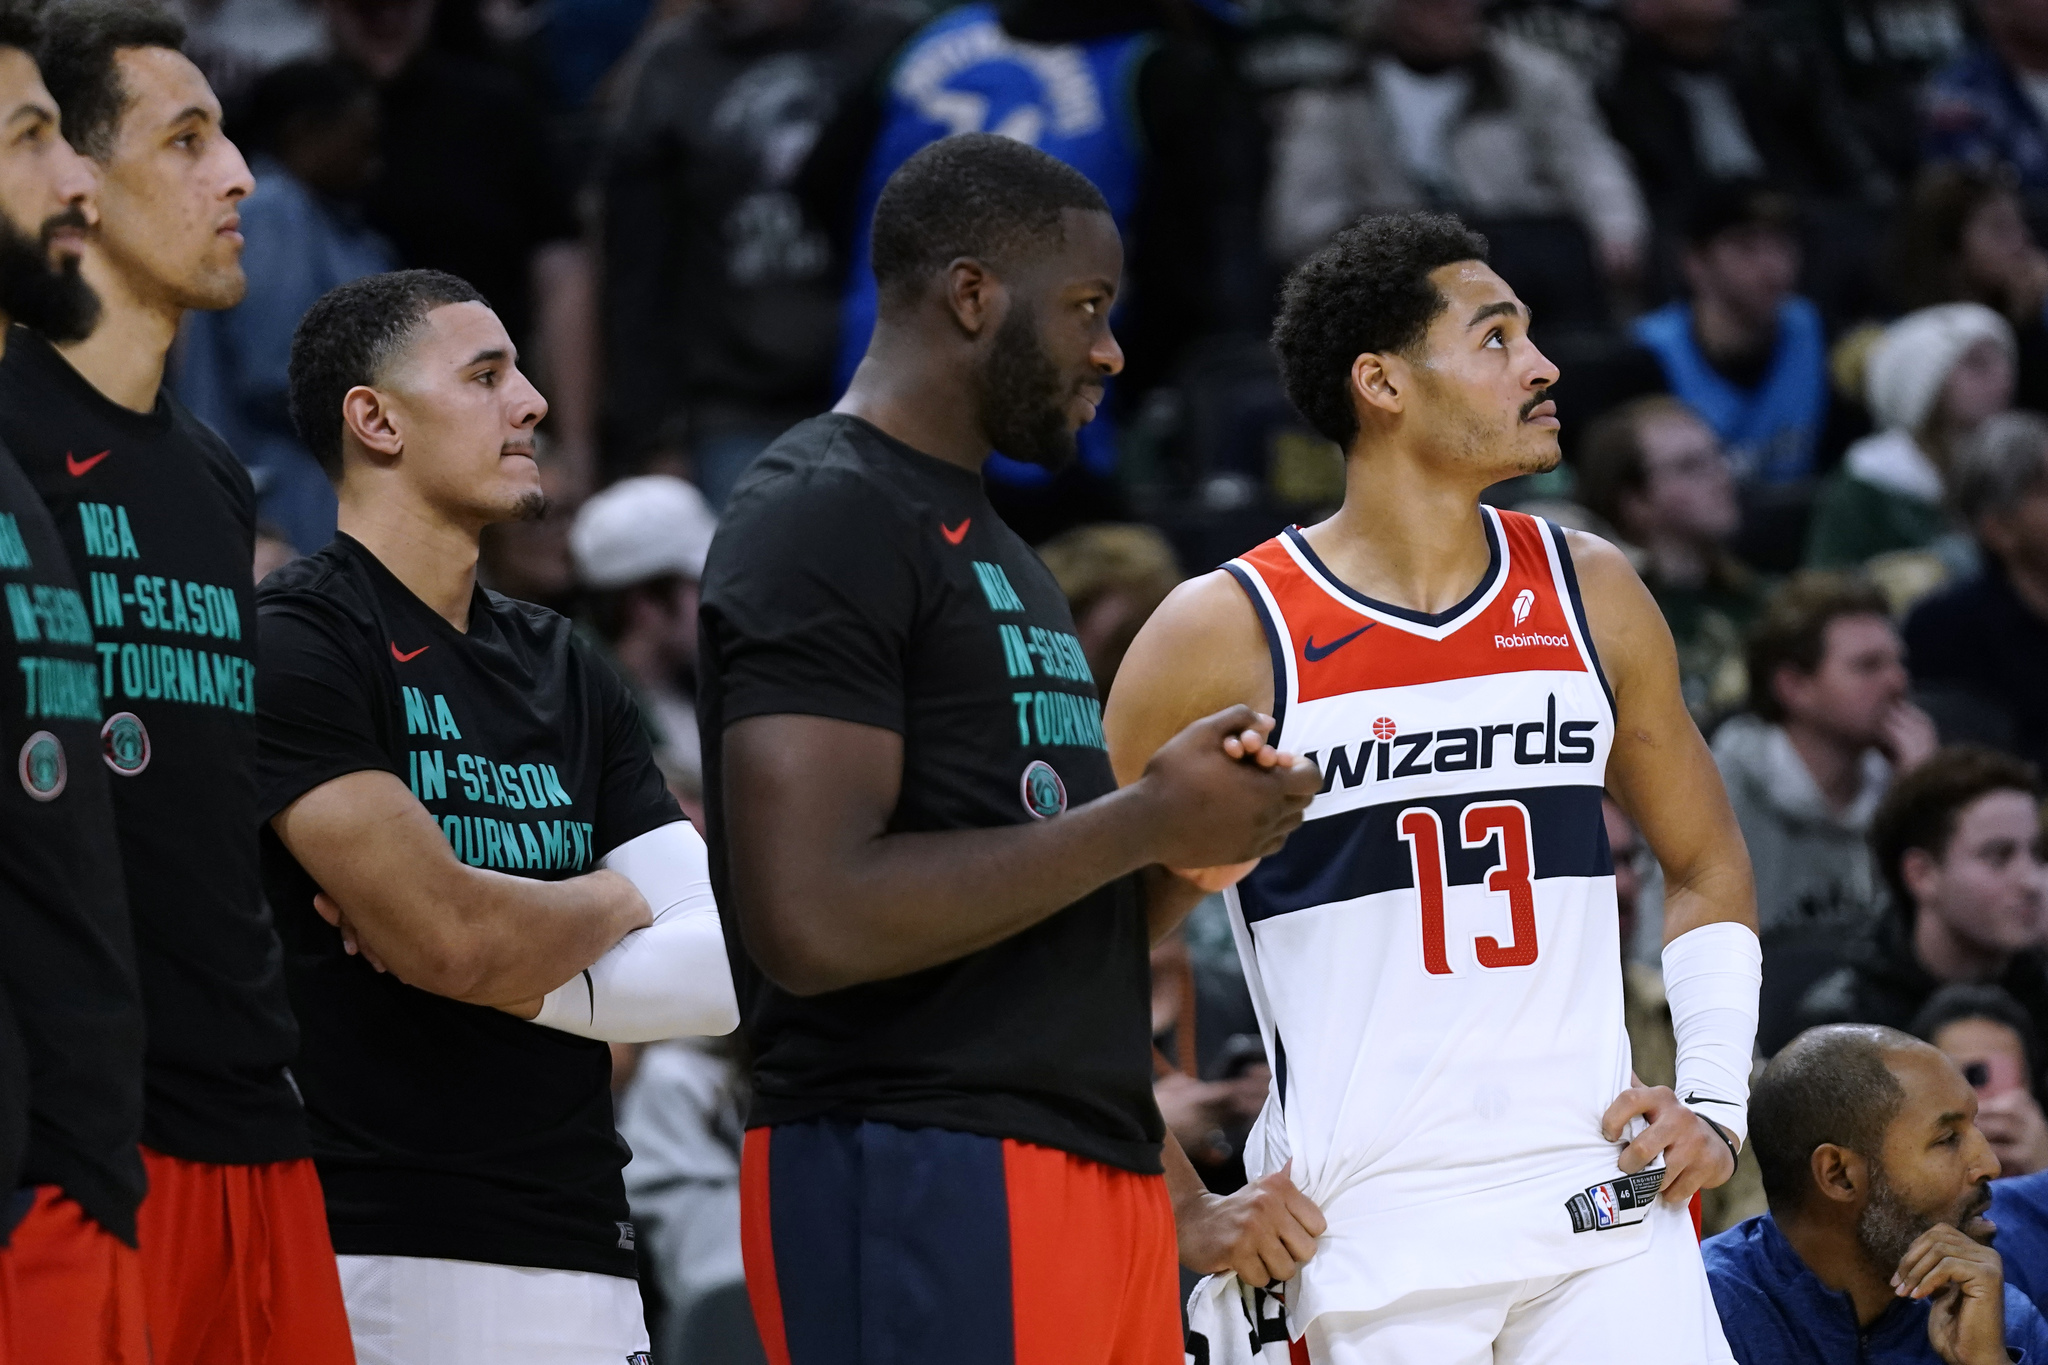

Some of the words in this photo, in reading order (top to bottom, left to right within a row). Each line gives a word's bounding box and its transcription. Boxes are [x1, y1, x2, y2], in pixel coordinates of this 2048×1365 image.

[78, 501, 140, 559] NBA
[90, 570, 242, 642] IN-SEASON
[970, 560, 1025, 612] NBA
[1494, 632, 1569, 649] Robinhood
[402, 686, 462, 740] NA
[1304, 692, 1599, 796] wizards
[410, 750, 573, 810] IN-SEASON
[432, 814, 594, 871] OURNAMENT
[1397, 800, 1539, 978] 13
[1620, 1189, 1631, 1199] 46
